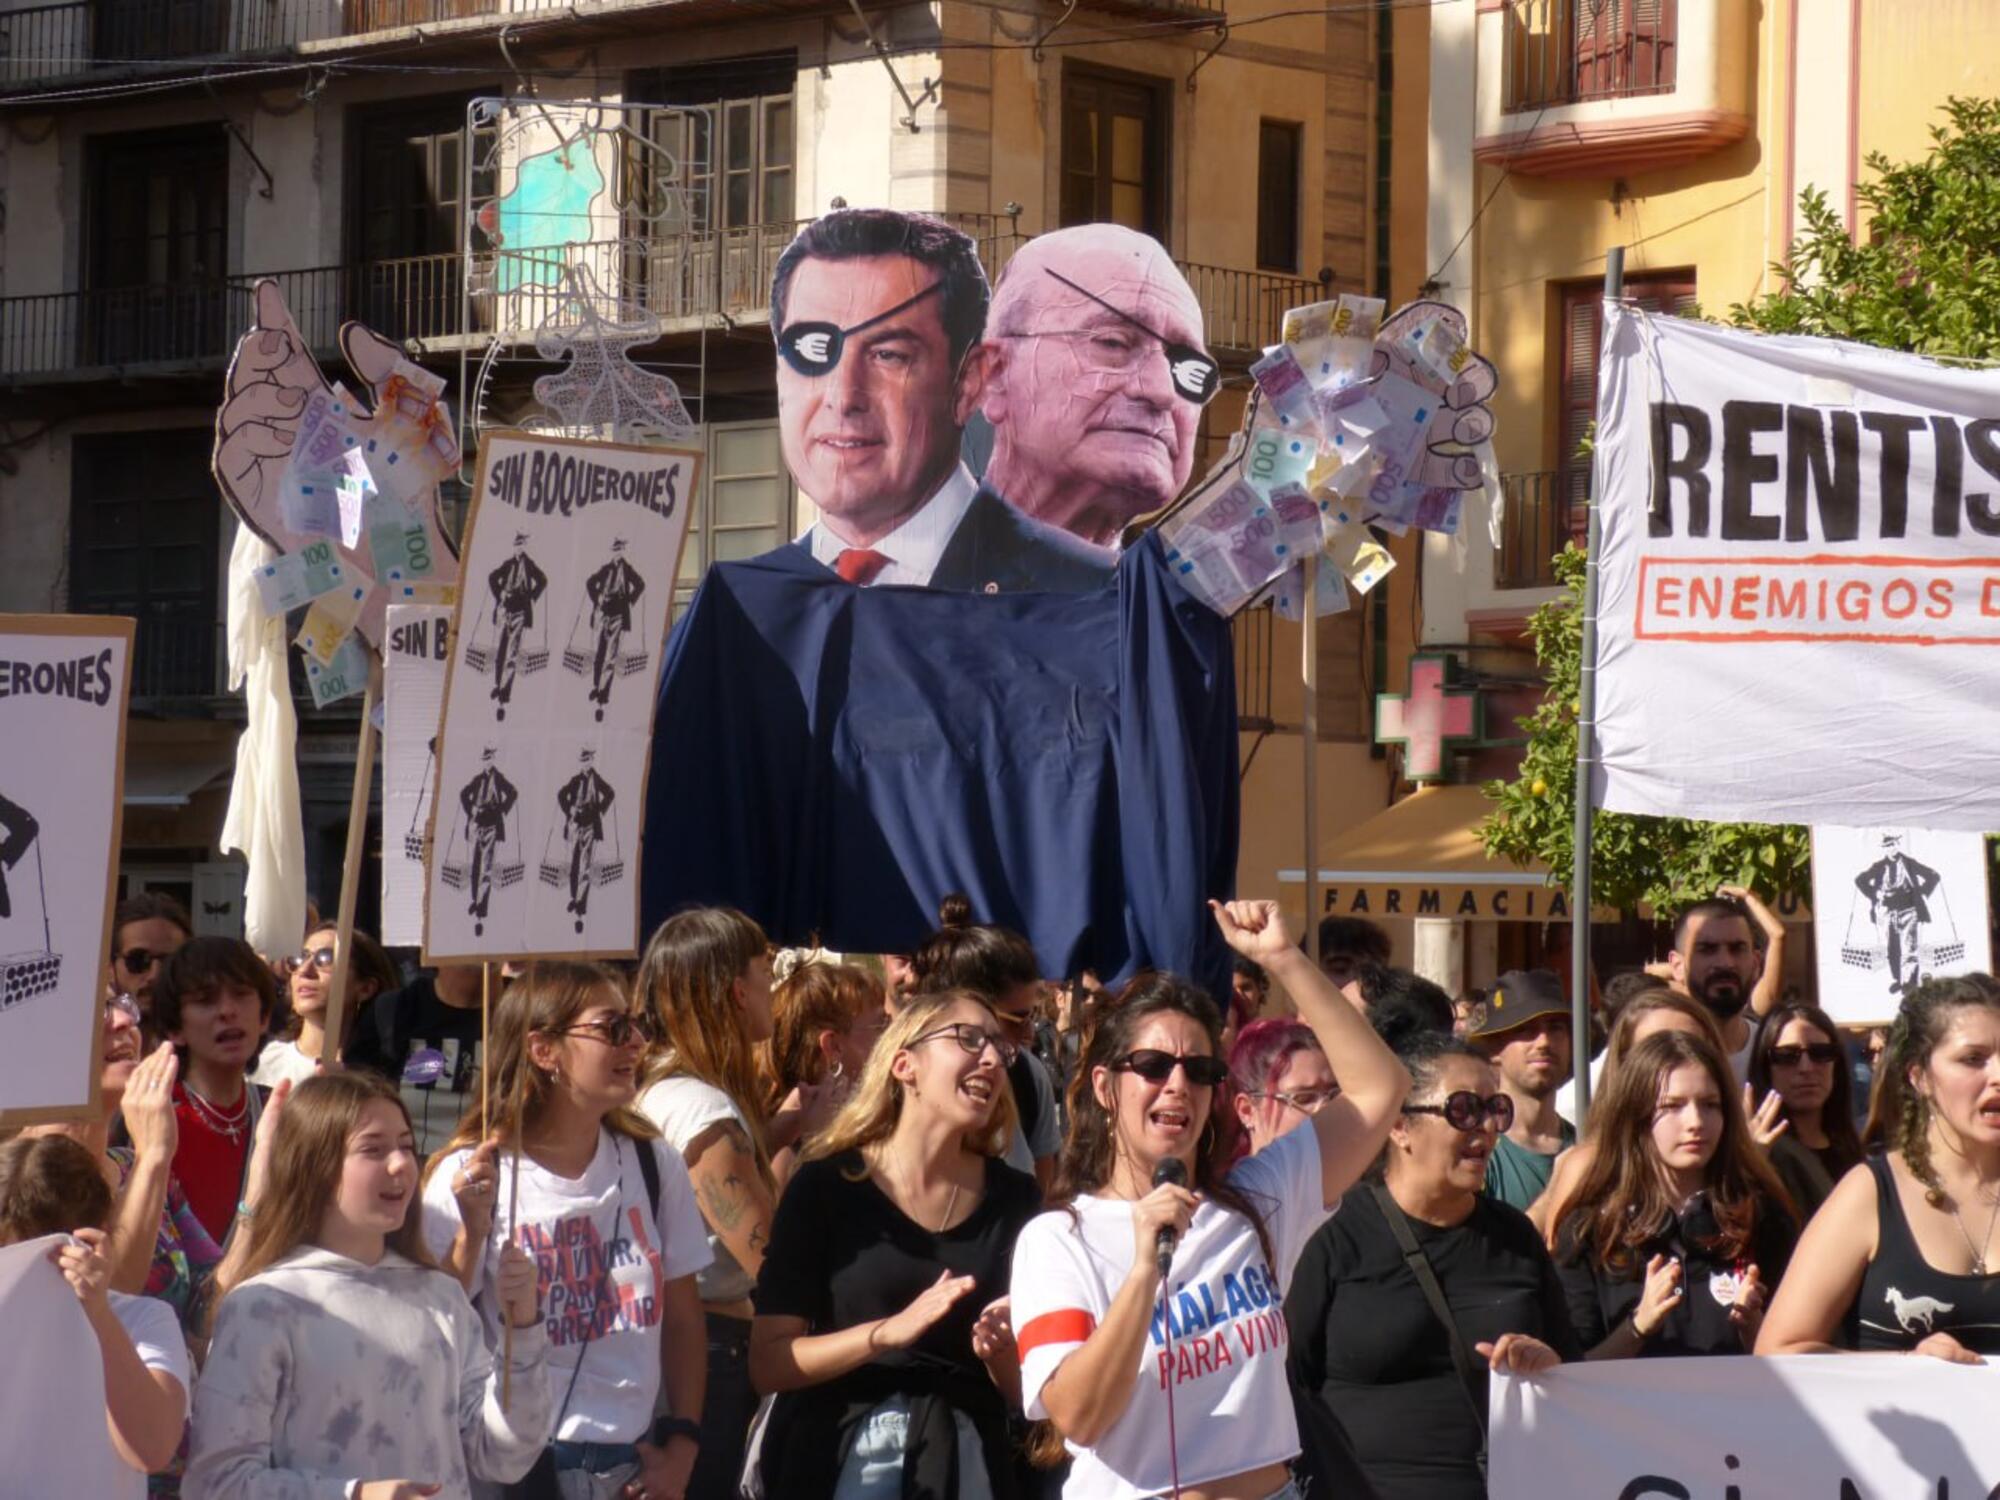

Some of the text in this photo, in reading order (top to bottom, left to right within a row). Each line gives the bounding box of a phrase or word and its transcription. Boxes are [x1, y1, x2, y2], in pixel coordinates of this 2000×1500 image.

[1252, 440, 1278, 480] 100
[489, 450, 680, 518] SIN BOQUERONES
[1207, 486, 1249, 527] 500
[301, 542, 330, 567] 100
[403, 526, 430, 571] 100
[1230, 517, 1274, 556] 500
[1655, 576, 1954, 621] ENEMIGOS
[391, 620, 428, 659] SIN
[1324, 888, 1568, 917] FARMACIA
[1157, 1330, 1232, 1390] PARA
